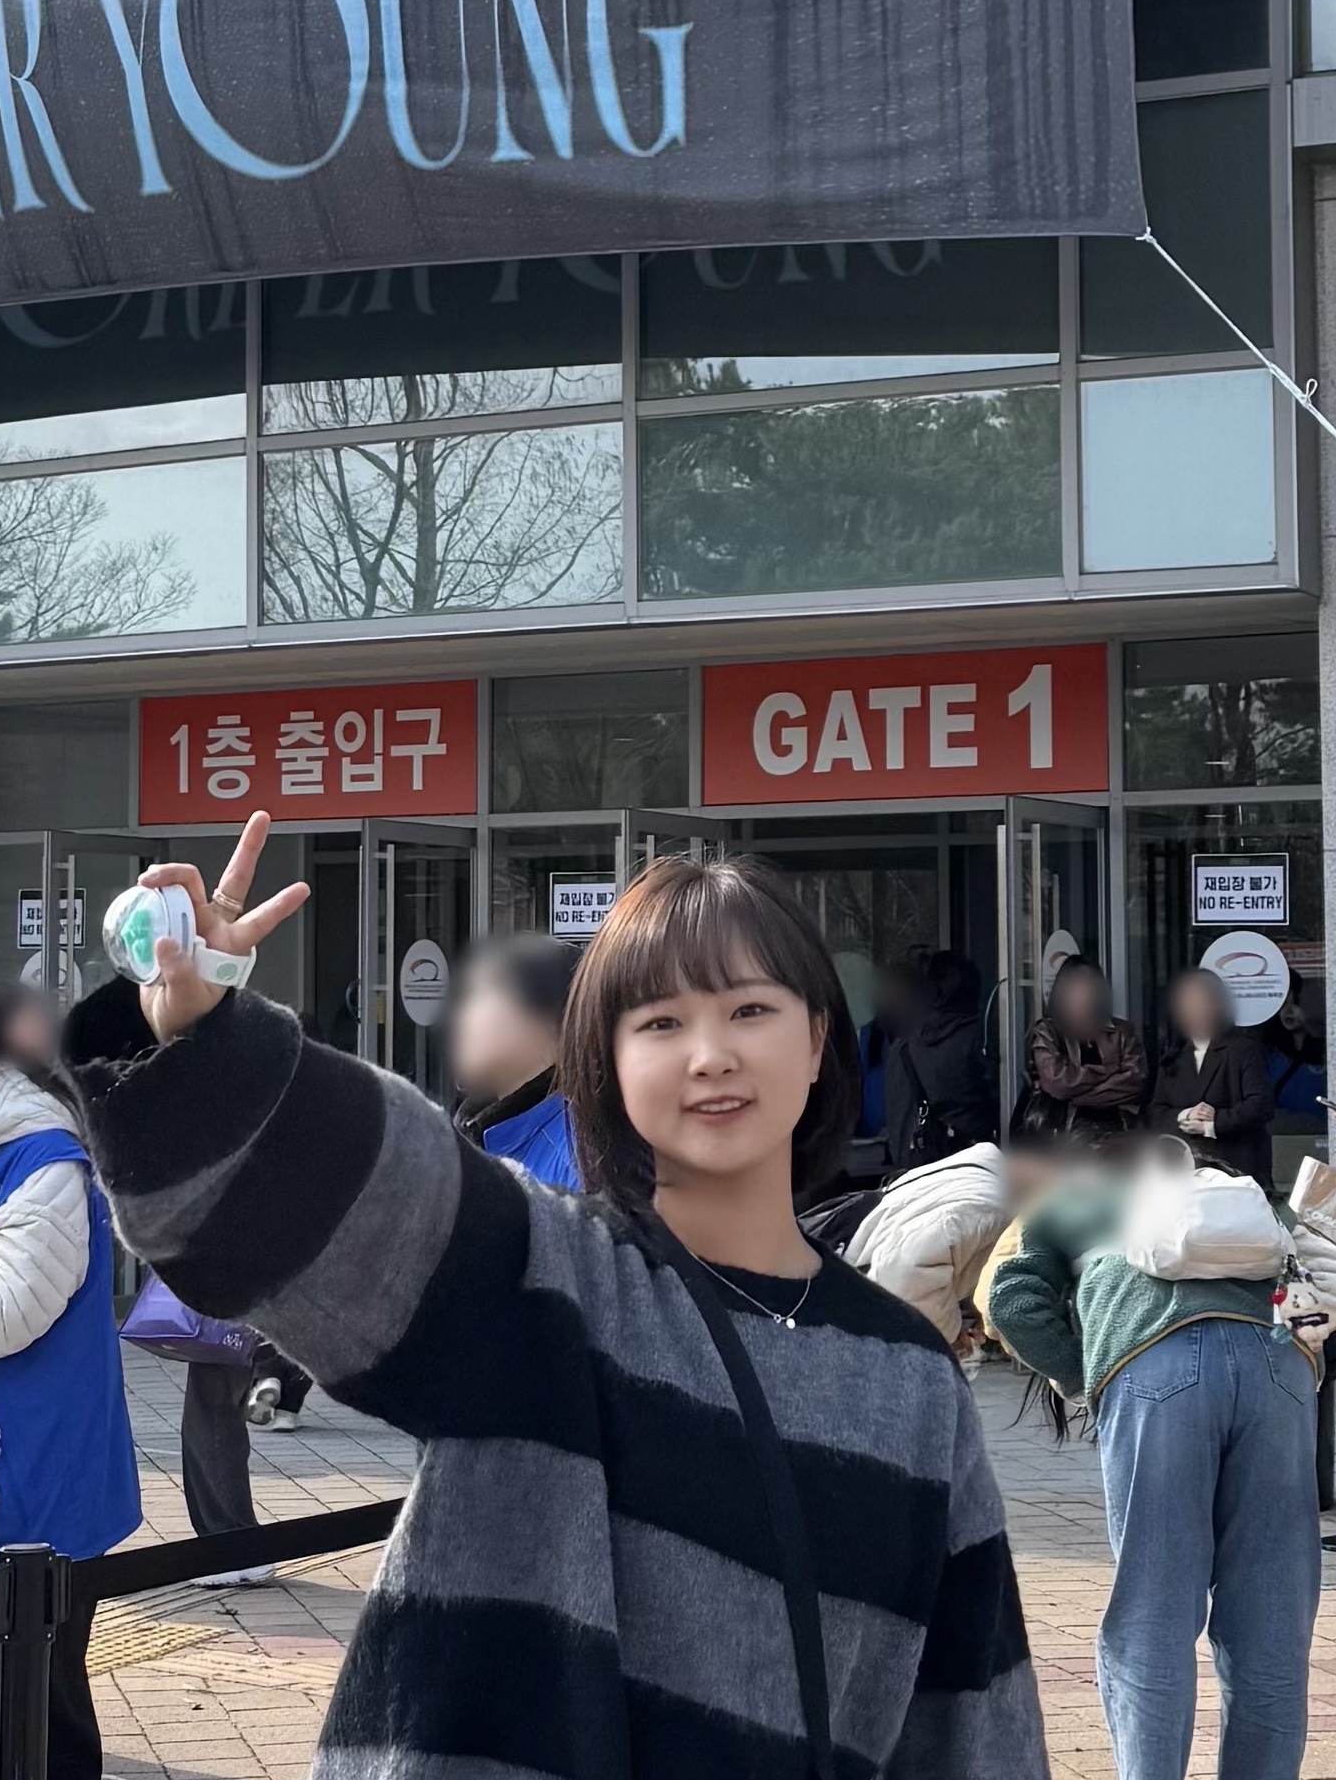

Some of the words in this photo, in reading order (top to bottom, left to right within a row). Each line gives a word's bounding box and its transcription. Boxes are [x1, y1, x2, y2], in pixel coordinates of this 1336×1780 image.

[752, 682, 979, 777] GATE
[1007, 664, 1054, 770] 1
[169, 715, 256, 800] 1층
[275, 708, 447, 795] 출입구
[1199, 896, 1215, 909] NO
[1219, 895, 1283, 909] RE-ENTRY
[1204, 876, 1245, 891] 재입장
[1250, 876, 1277, 891] 불가
